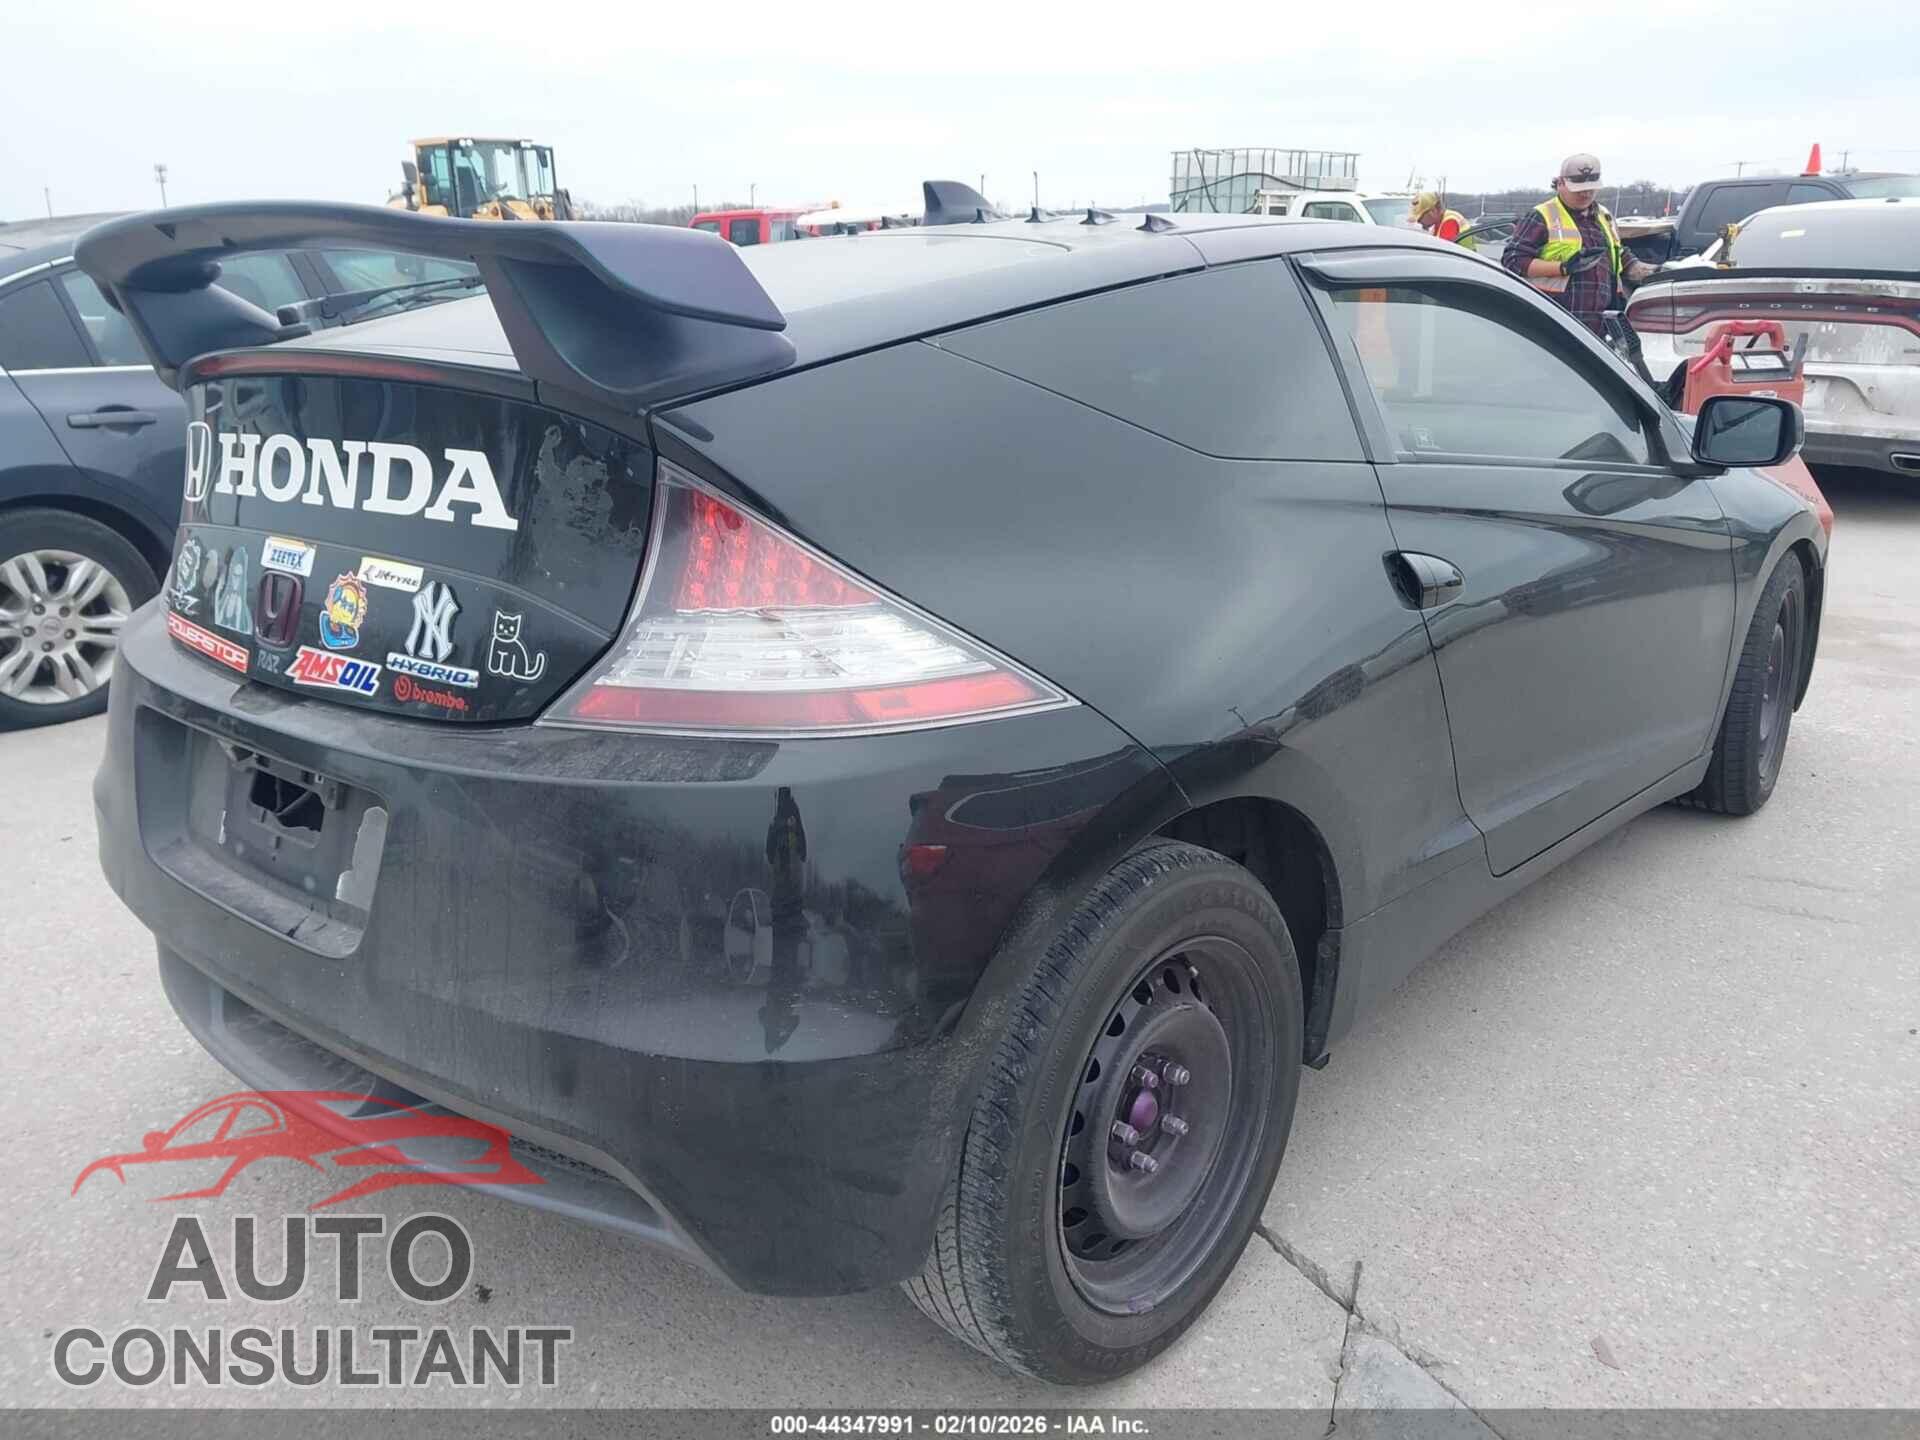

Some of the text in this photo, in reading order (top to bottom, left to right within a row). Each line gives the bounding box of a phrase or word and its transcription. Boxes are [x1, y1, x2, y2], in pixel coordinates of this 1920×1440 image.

[215, 433, 518, 531] HONDA
[271, 549, 305, 569] ZEETEX
[169, 618, 248, 666] POWERSTOP
[292, 648, 378, 694] AMSOIL
[391, 656, 473, 684] HYBRID
